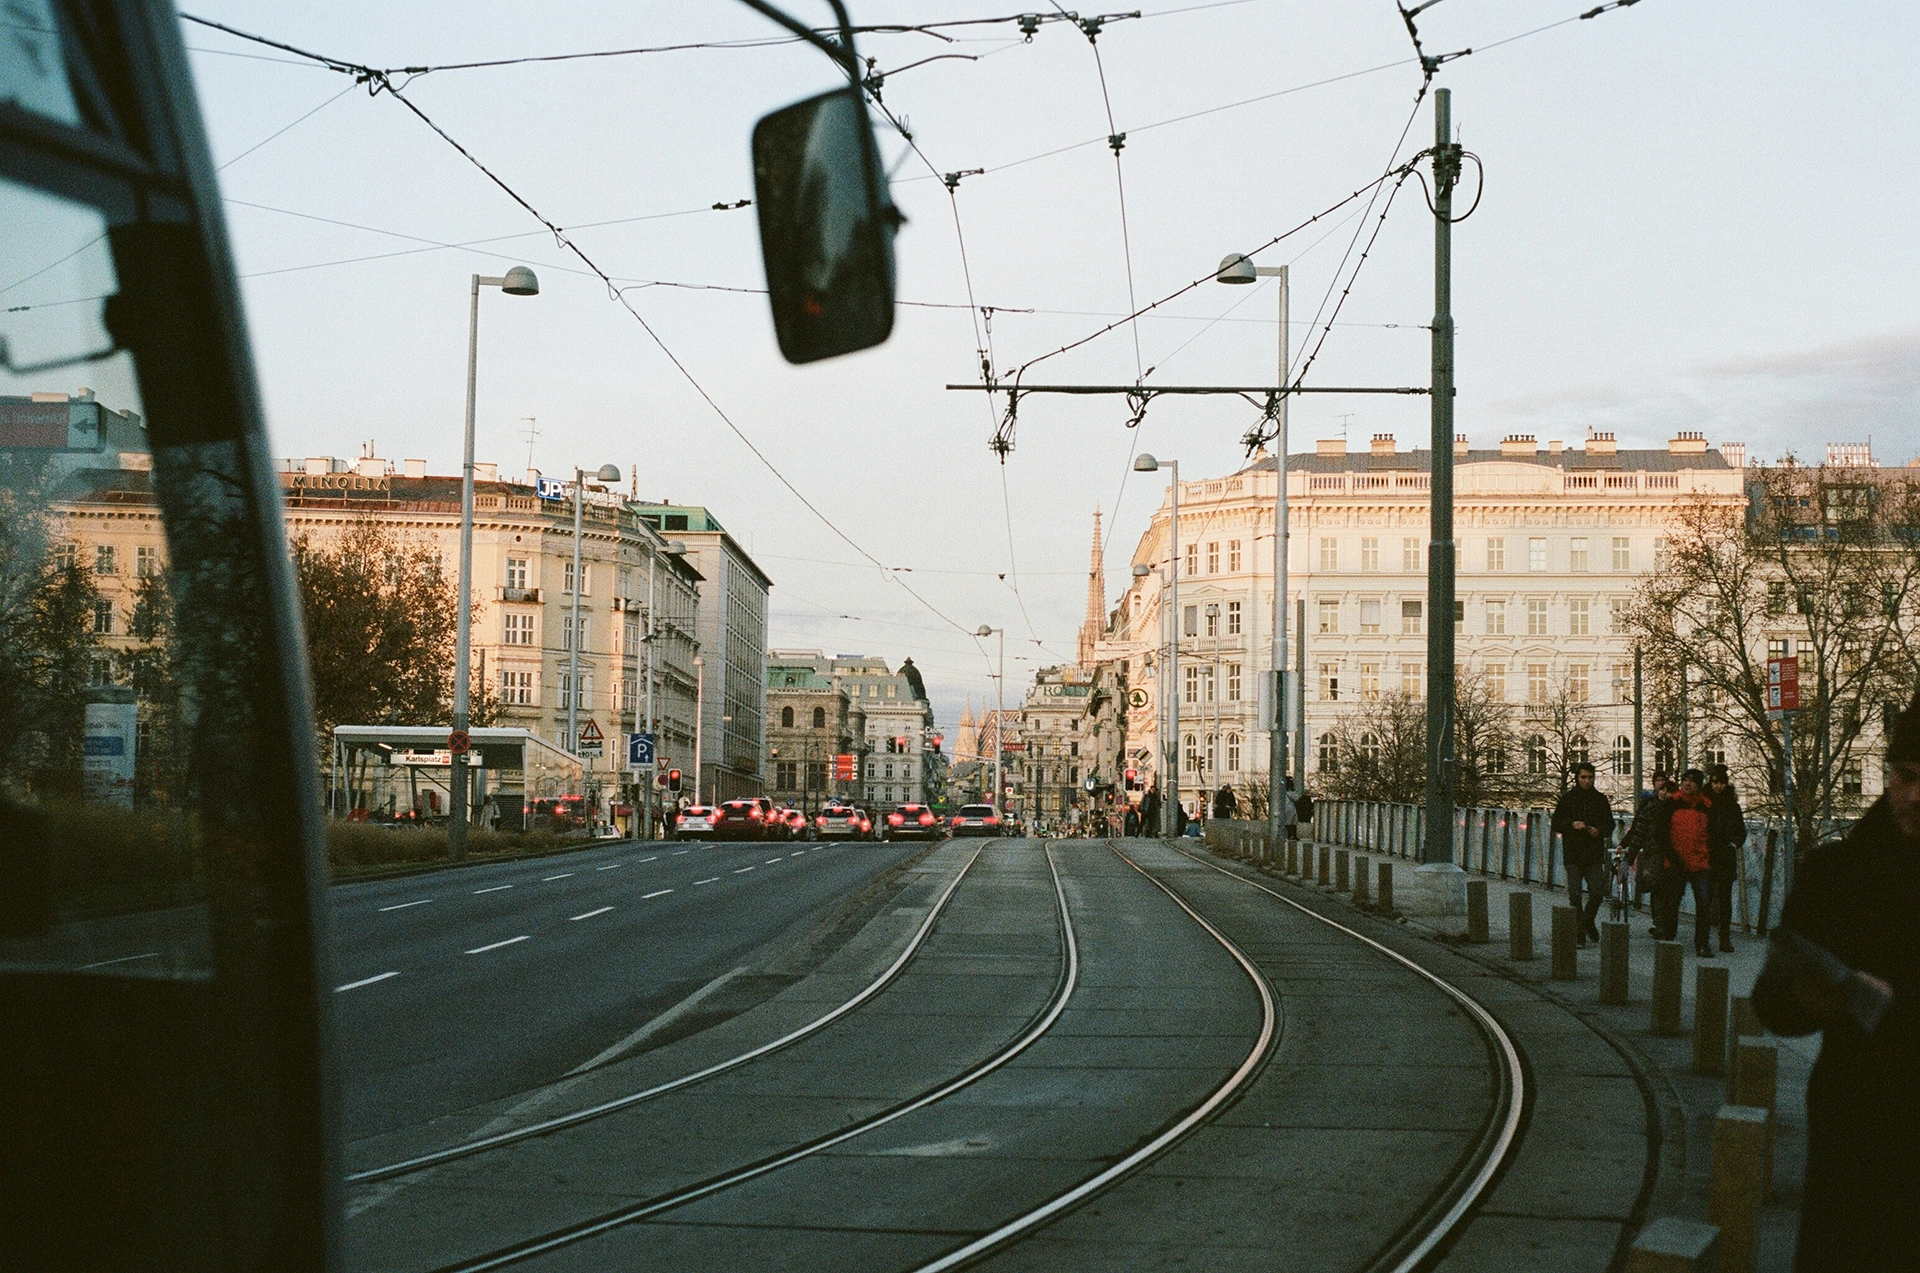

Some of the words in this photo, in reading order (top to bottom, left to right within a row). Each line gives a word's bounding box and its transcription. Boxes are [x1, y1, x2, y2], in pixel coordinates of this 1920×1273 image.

[291, 475, 390, 491] MINOLTA
[540, 480, 562, 497] JP
[637, 743, 648, 758] P
[405, 756, 442, 764] Karlsplatz
[1086, 781, 1094, 790] U
